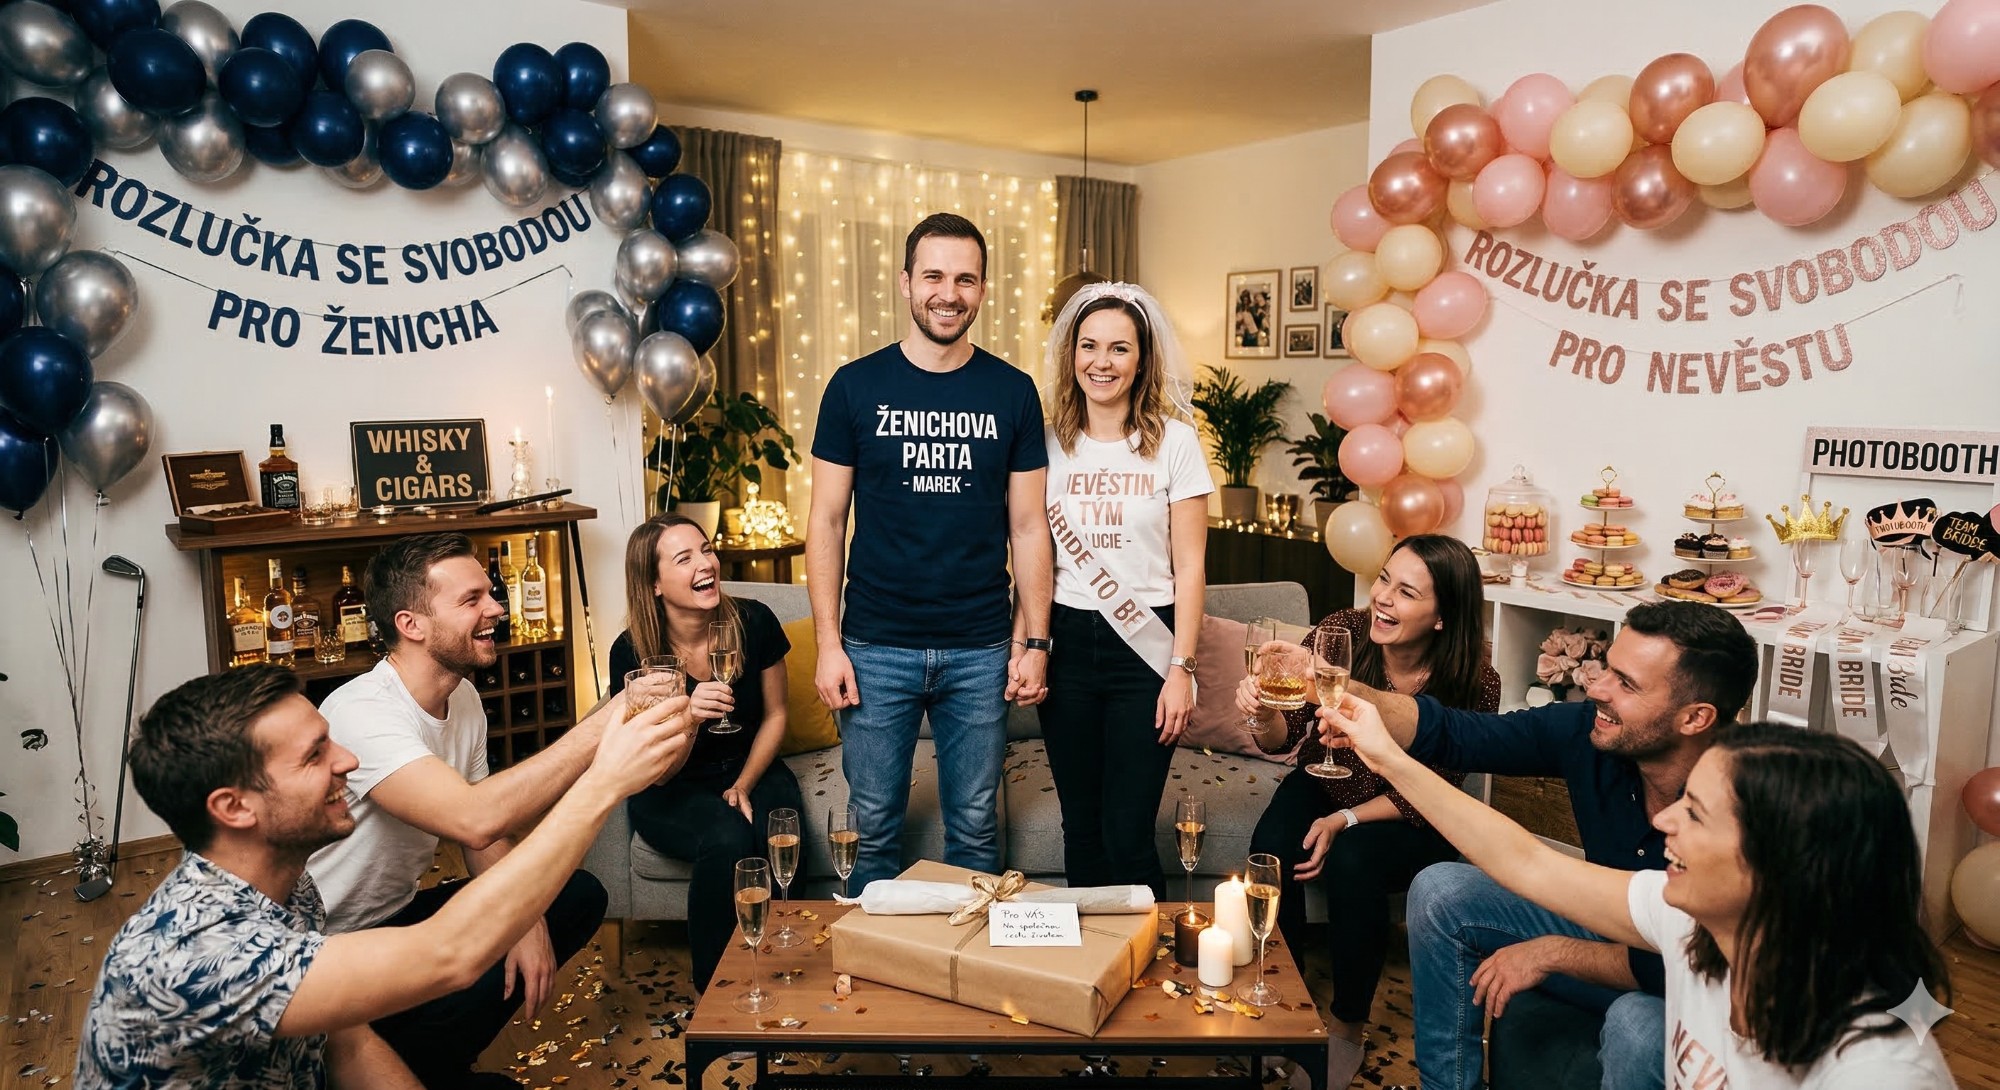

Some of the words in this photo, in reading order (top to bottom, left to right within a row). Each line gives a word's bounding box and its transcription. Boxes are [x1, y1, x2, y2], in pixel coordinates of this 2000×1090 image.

[74, 158, 320, 281] ROZLUČKA
[336, 243, 389, 285] SE
[404, 193, 593, 284] SVOBODOU
[1464, 230, 1639, 320] ROZLUČKA
[1657, 279, 1710, 322] SE
[1729, 178, 1998, 317] SVOBODOU
[208, 290, 301, 348] PRO
[322, 299, 499, 355] ŽENICHA
[1549, 329, 1626, 385] PRO
[1646, 323, 1853, 394] NEVĚSTU
[876, 405, 998, 439] ŽENICHOVA
[367, 428, 471, 453] WHISKY
[903, 442, 973, 470] PARTA
[1812, 438, 2000, 475] PHOTOBOOTH
[416, 454, 433, 474] &
[376, 473, 473, 501] CIGARS
[913, 475, 961, 493] MAREK
[1079, 497, 1124, 526] TÝM
[1047, 500, 1094, 570] BRIDE
[1089, 567, 1119, 600] TO
[1113, 598, 1147, 634] BE
[1777, 642, 1807, 699] BRIDE
[1838, 660, 1868, 718] BRIDE
[1001, 909, 1020, 919] Pro
